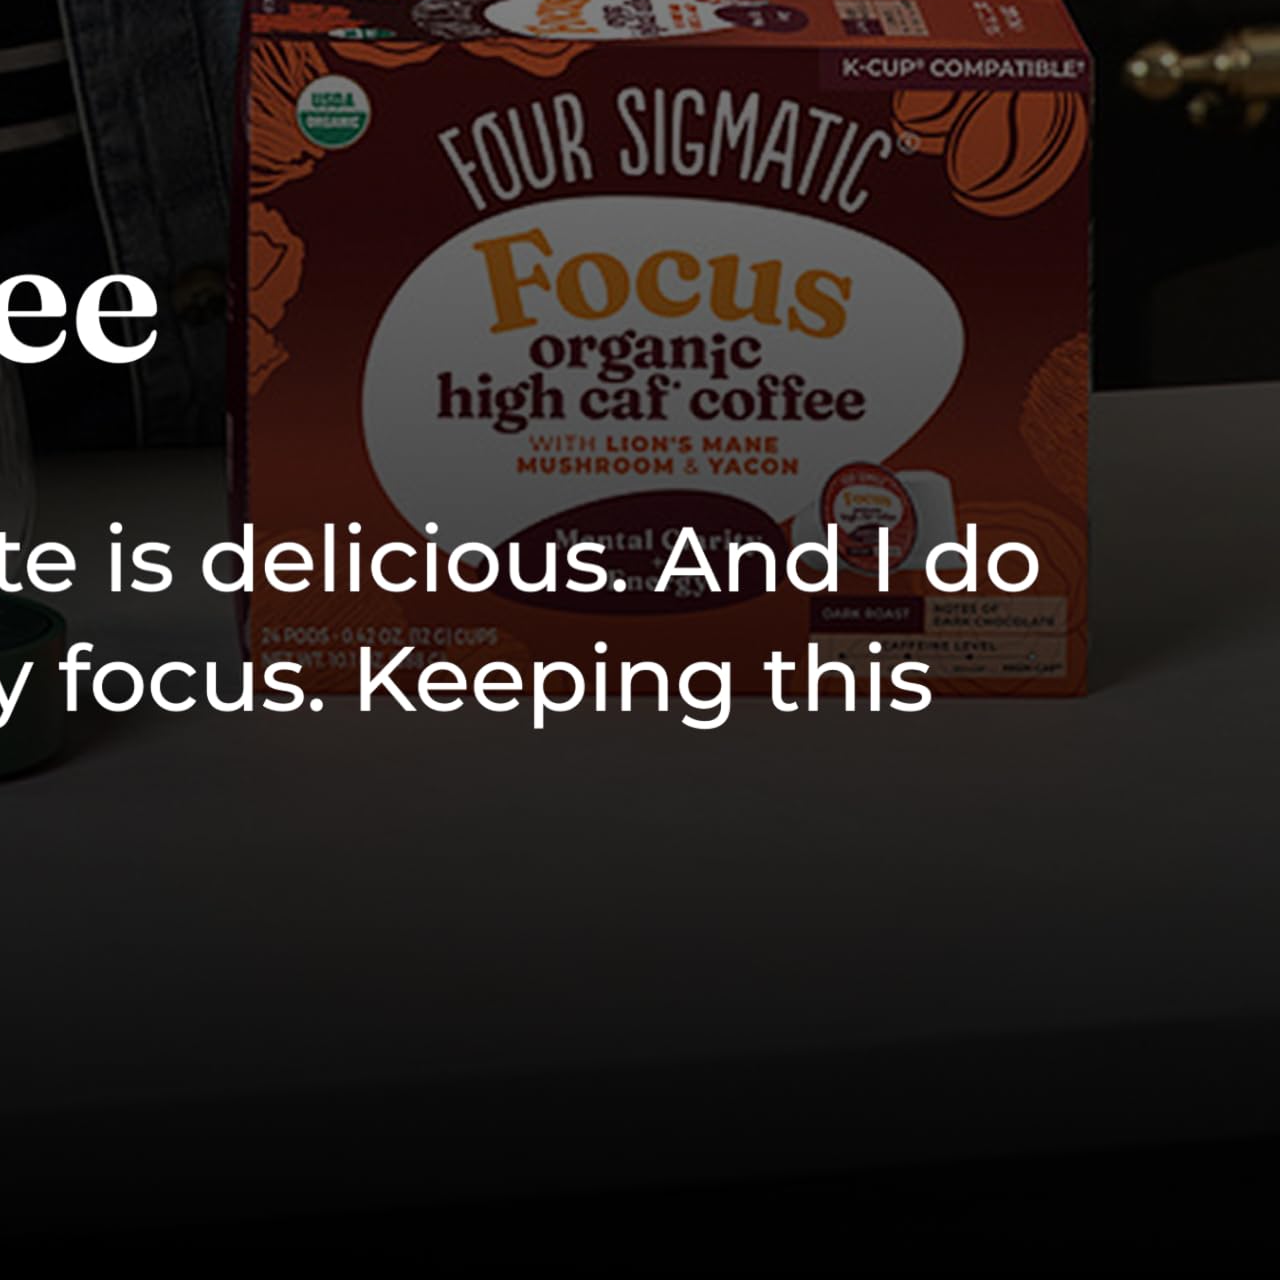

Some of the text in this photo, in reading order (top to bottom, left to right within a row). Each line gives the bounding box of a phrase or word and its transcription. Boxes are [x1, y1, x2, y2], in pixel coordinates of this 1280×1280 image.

[438, 90, 594, 212] FOUR
[474, 228, 852, 339] Focus
[530, 330, 762, 383] organic
[438, 372, 565, 433] high
[690, 374, 866, 421] coffee
[517, 458, 674, 475] MUSHROOM
[709, 458, 800, 475] YACON
[529, 436, 778, 453] WITH LION'S MANE
